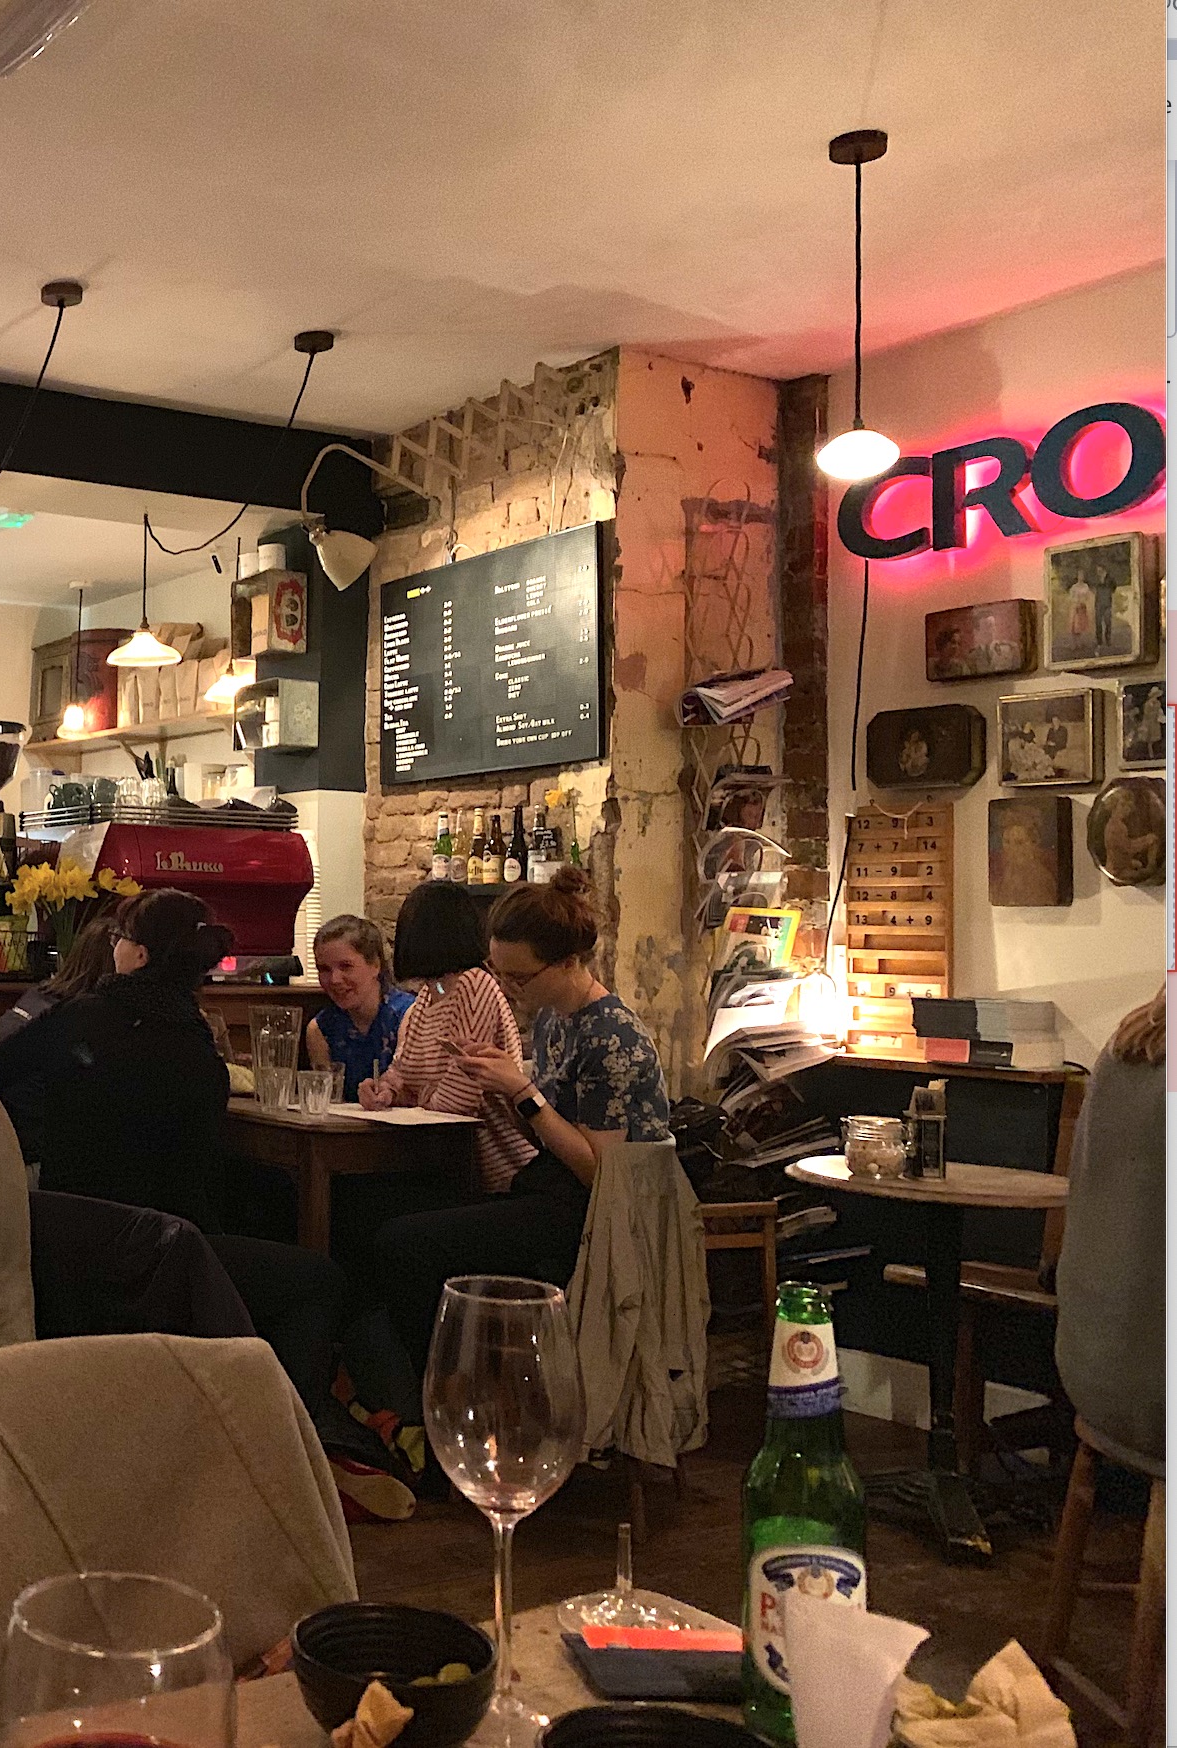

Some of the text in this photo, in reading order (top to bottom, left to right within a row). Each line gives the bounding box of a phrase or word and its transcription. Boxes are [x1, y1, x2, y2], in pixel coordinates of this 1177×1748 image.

[837, 402, 1166, 560] CRO
[495, 712, 527, 724] EXTRA SHOT
[857, 819, 871, 829] 12
[891, 817, 899, 829] 9
[925, 816, 934, 826] 3
[857, 842, 864, 853] 7
[892, 841, 899, 852] 7
[922, 840, 937, 850] 14
[856, 867, 869, 877] 11
[890, 866, 898, 876] 9
[925, 865, 934, 876] 2
[856, 891, 869, 901] 12
[890, 890, 897, 900] 8
[926, 890, 934, 901] 4
[855, 914, 868, 925] 13
[890, 915, 897, 926] 4
[924, 915, 933, 926] 9
[888, 986, 896, 997] 9
[925, 988, 932, 999] 6
